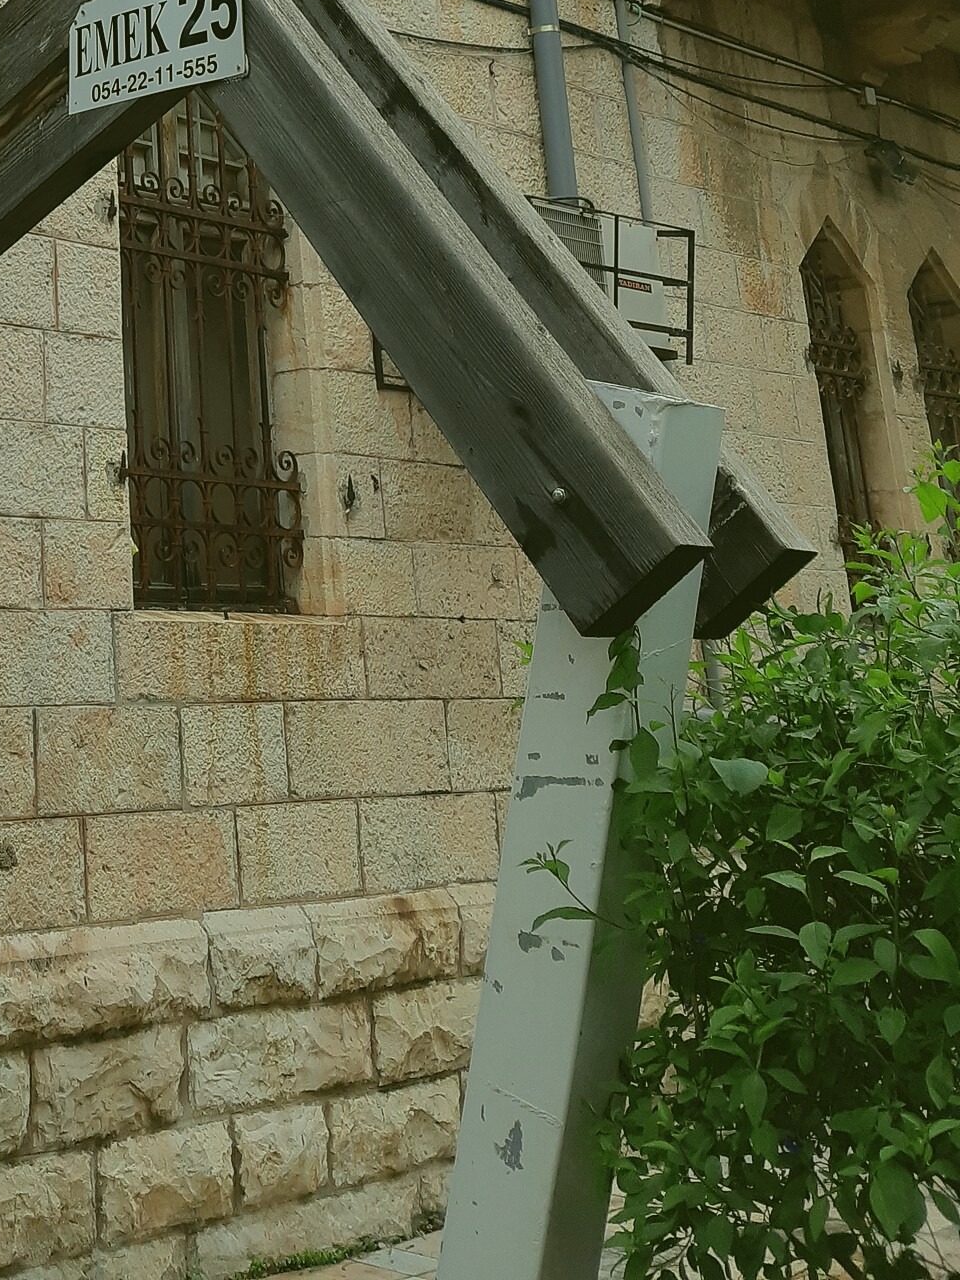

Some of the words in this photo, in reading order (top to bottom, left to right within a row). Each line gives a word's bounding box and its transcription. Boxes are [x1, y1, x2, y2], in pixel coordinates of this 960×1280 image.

[74, 0, 170, 79] EMEK
[91, 53, 218, 103] 054-22-11-555
[618, 278, 651, 292] TADIRAN
